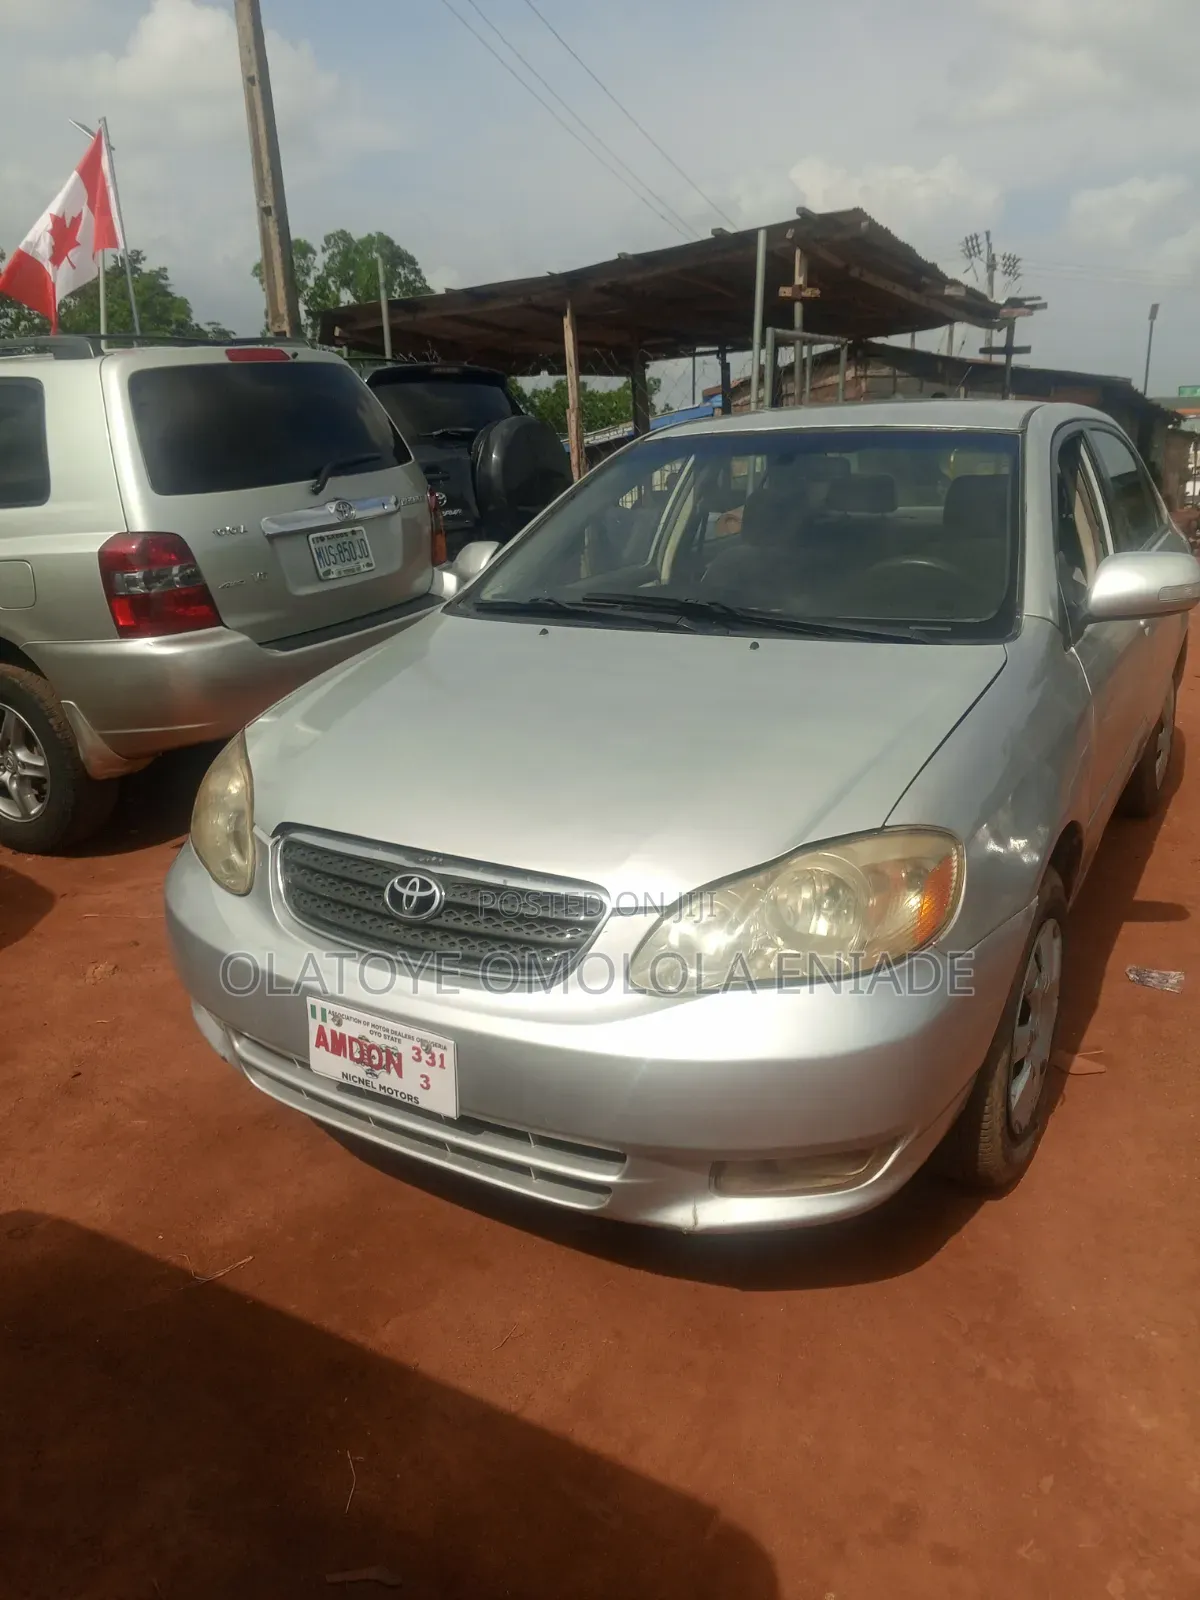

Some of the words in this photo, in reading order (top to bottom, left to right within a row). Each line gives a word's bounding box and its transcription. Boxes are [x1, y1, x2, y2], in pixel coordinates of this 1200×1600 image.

[362, 1020, 371, 1028] OF
[371, 1022, 390, 1035] MOTOR
[391, 1029, 415, 1043] DEALERS
[369, 1029, 382, 1038] OYO
[383, 1033, 403, 1046] STATE
[315, 1024, 403, 1079] AMDON
[411, 1045, 446, 1070] 331
[341, 1071, 376, 1090] NICNEL
[378, 1083, 420, 1105] MOTORS
[419, 1073, 431, 1091] 3
